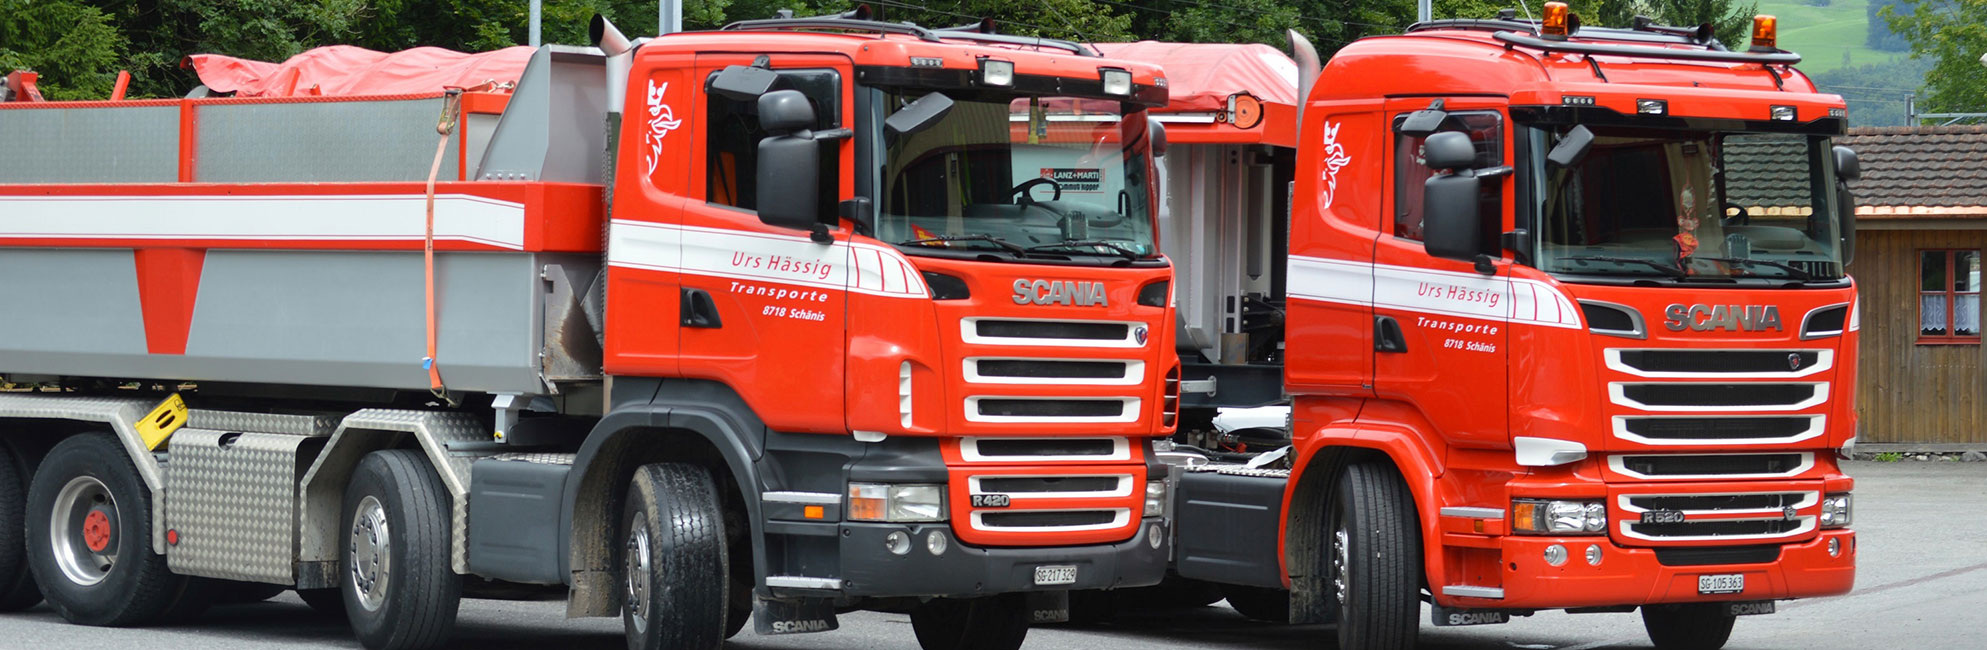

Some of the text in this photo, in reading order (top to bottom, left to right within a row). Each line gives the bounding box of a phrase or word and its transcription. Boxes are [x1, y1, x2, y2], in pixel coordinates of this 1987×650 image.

[1054, 171, 1099, 179] LANZ+MARTI
[732, 251, 832, 280] Urs Hässig
[729, 281, 828, 302] Transporte
[1012, 278, 1108, 307] SCANIA
[1418, 282, 1500, 308] Urs Hässig
[762, 304, 825, 322] 8718 Schänis
[1664, 303, 1783, 332] SCANIA
[1417, 316, 1498, 335] Transporte
[1443, 338, 1496, 353] 8718 Schänis
[1034, 609, 1069, 622] SCANIA
[1731, 602, 1773, 615] SCANIA
[772, 619, 829, 633] SCANIA
[1449, 612, 1502, 625] SCANIA
